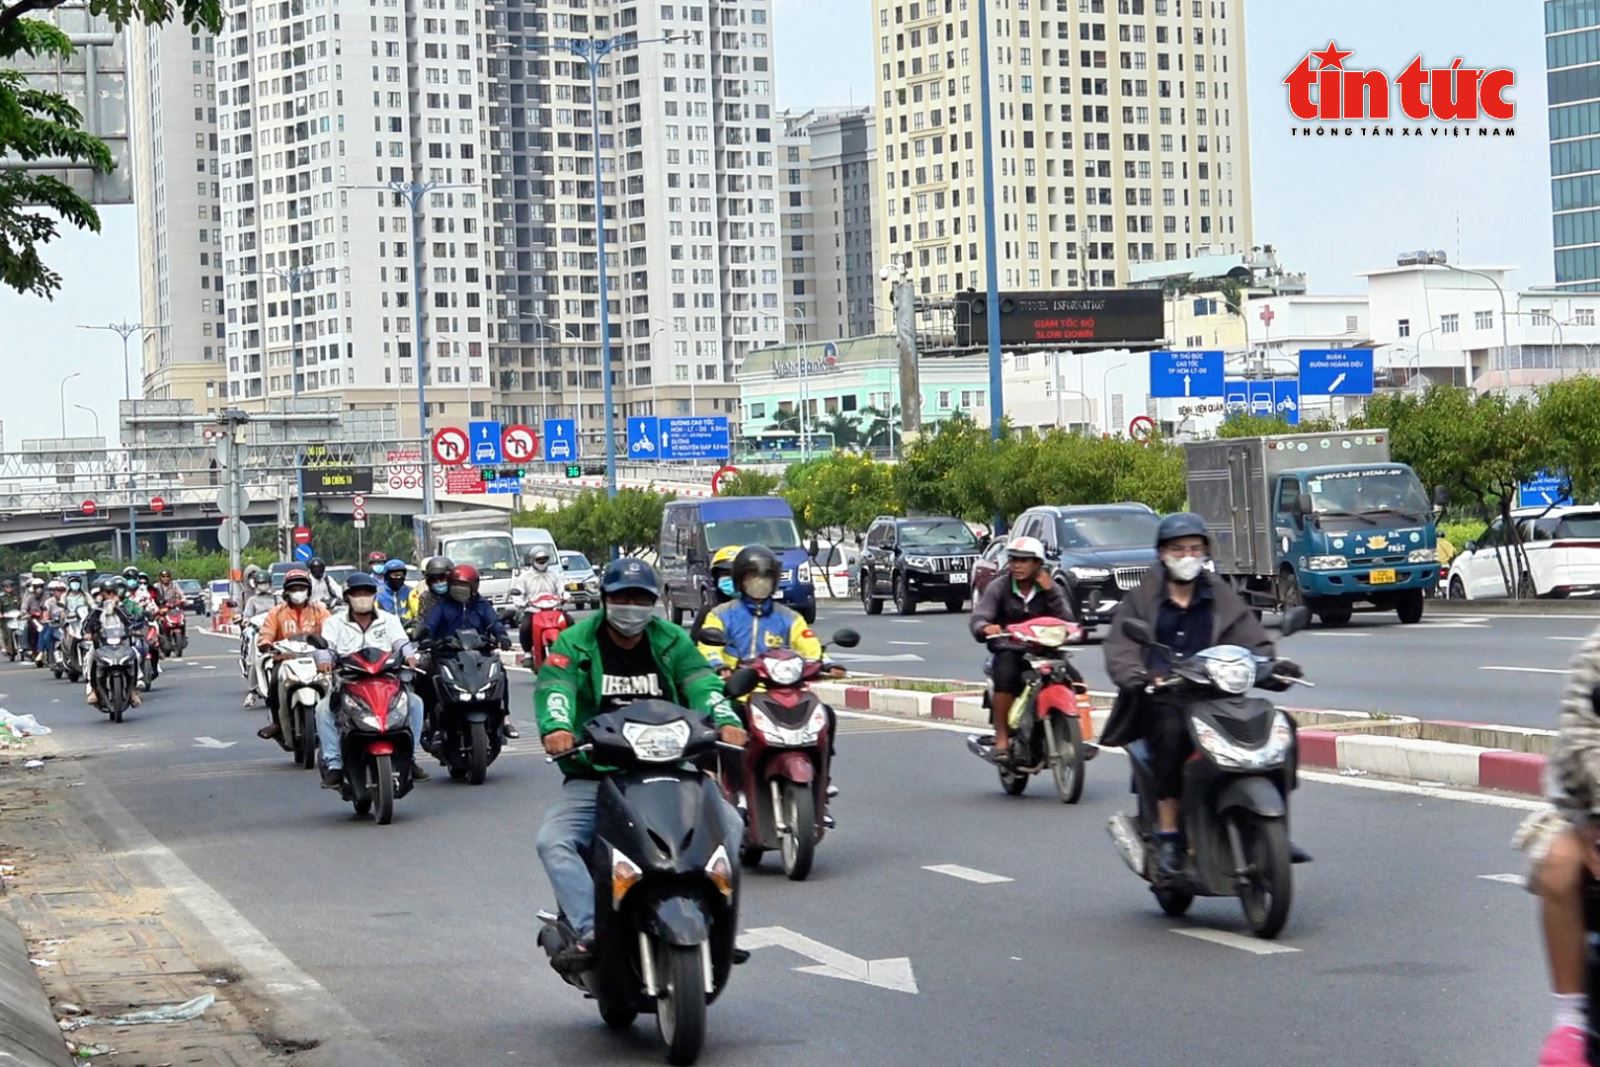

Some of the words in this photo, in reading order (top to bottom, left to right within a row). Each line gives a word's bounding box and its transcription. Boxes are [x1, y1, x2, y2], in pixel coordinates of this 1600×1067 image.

[1036, 330, 1062, 339] SLOW
[1064, 330, 1094, 338] DOWN
[483, 471, 494, 479] 36
[567, 467, 579, 477] 36
[764, 630, 784, 648] be
